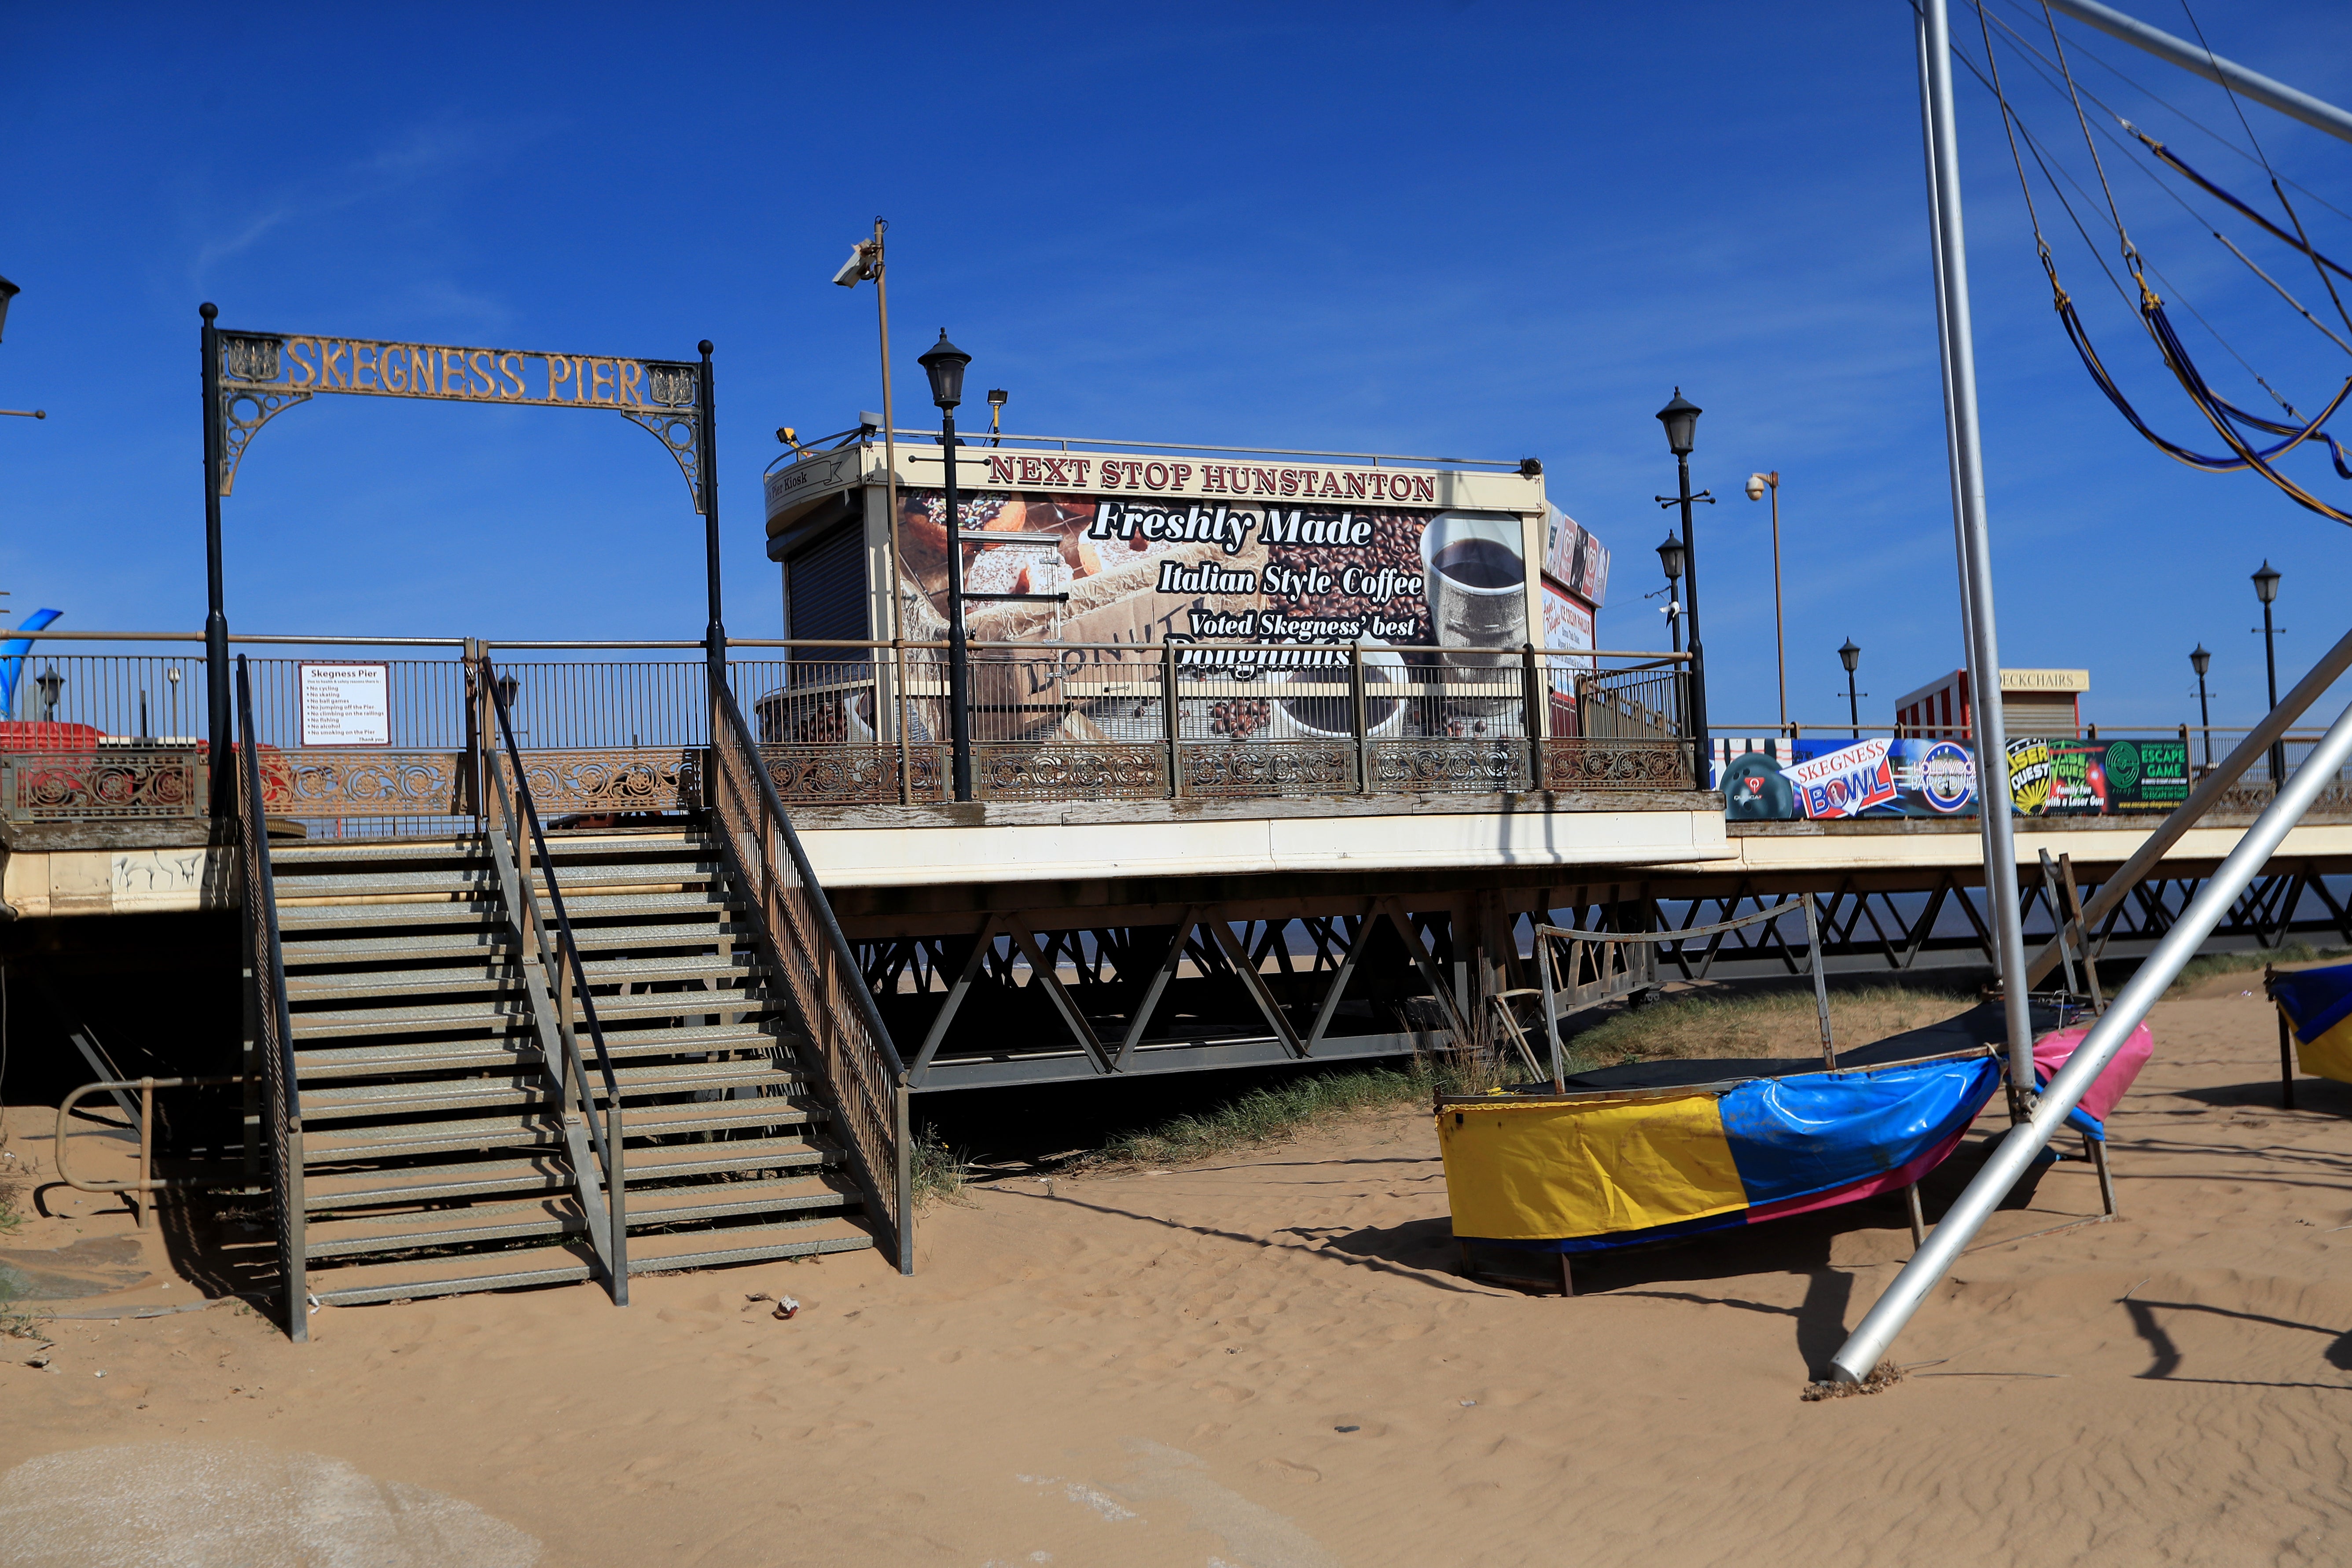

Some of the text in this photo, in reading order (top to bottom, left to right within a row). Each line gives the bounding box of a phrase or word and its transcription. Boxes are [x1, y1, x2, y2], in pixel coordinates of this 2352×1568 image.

[287, 337, 526, 400] SKEGNESS
[545, 354, 643, 406] PIER
[772, 485, 783, 499] Pier
[784, 472, 807, 492] Kiosk
[988, 455, 1436, 502] NEXT STOP HUNSTANTON
[1092, 501, 1372, 552] Freshly Made
[1159, 564, 1422, 603] Italian Style Coffee
[1190, 613, 1253, 635] Voted
[1372, 615, 1415, 636] best
[1173, 638, 1350, 678] Doughnuts
[311, 669, 377, 679] Skegness Pier
[1797, 740, 1885, 783] SKEGNESS
[2006, 746, 2048, 777] ASER
[2141, 749, 2186, 763] ESCAPE
[1911, 775, 1978, 791] BAR & DINE
[2010, 763, 2050, 791] QUEST
[2146, 764, 2182, 778] GAME
[1808, 764, 1891, 816] BOWL
[2045, 795, 2104, 807] with a Laser Gun
[2056, 784, 2092, 796] Family Fun
